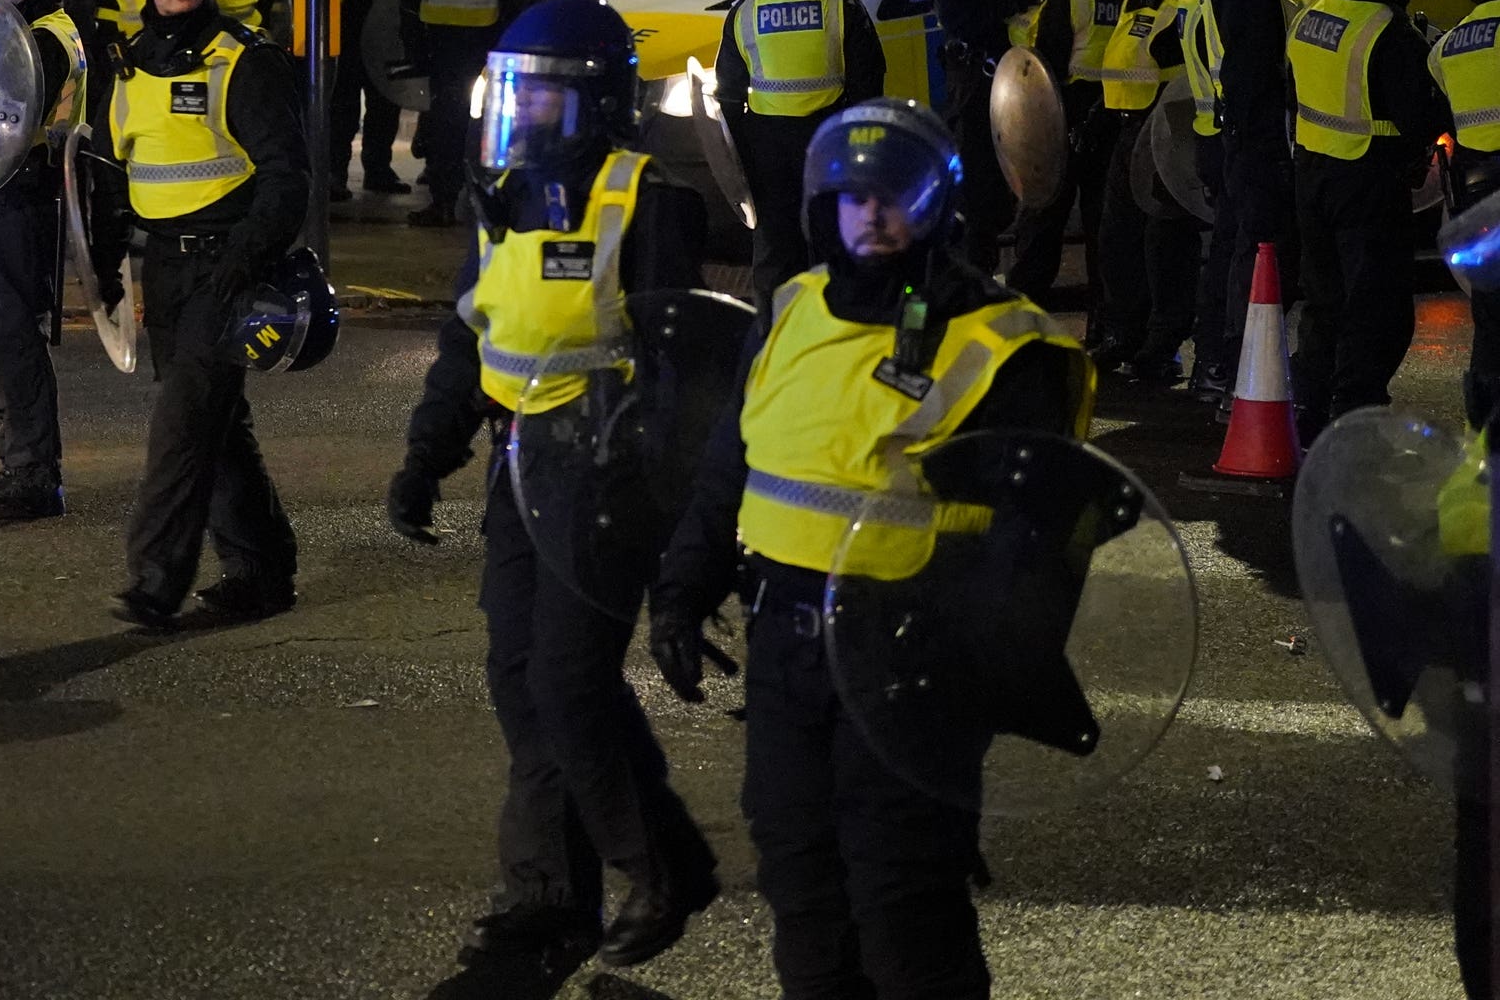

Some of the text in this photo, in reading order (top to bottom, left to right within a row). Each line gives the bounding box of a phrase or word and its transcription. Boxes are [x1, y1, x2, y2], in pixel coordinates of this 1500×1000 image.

[759, 5, 820, 28] POLICE
[1303, 13, 1343, 44] POLICE
[1446, 22, 1495, 51] POLICE
[849, 125, 886, 146] MP
